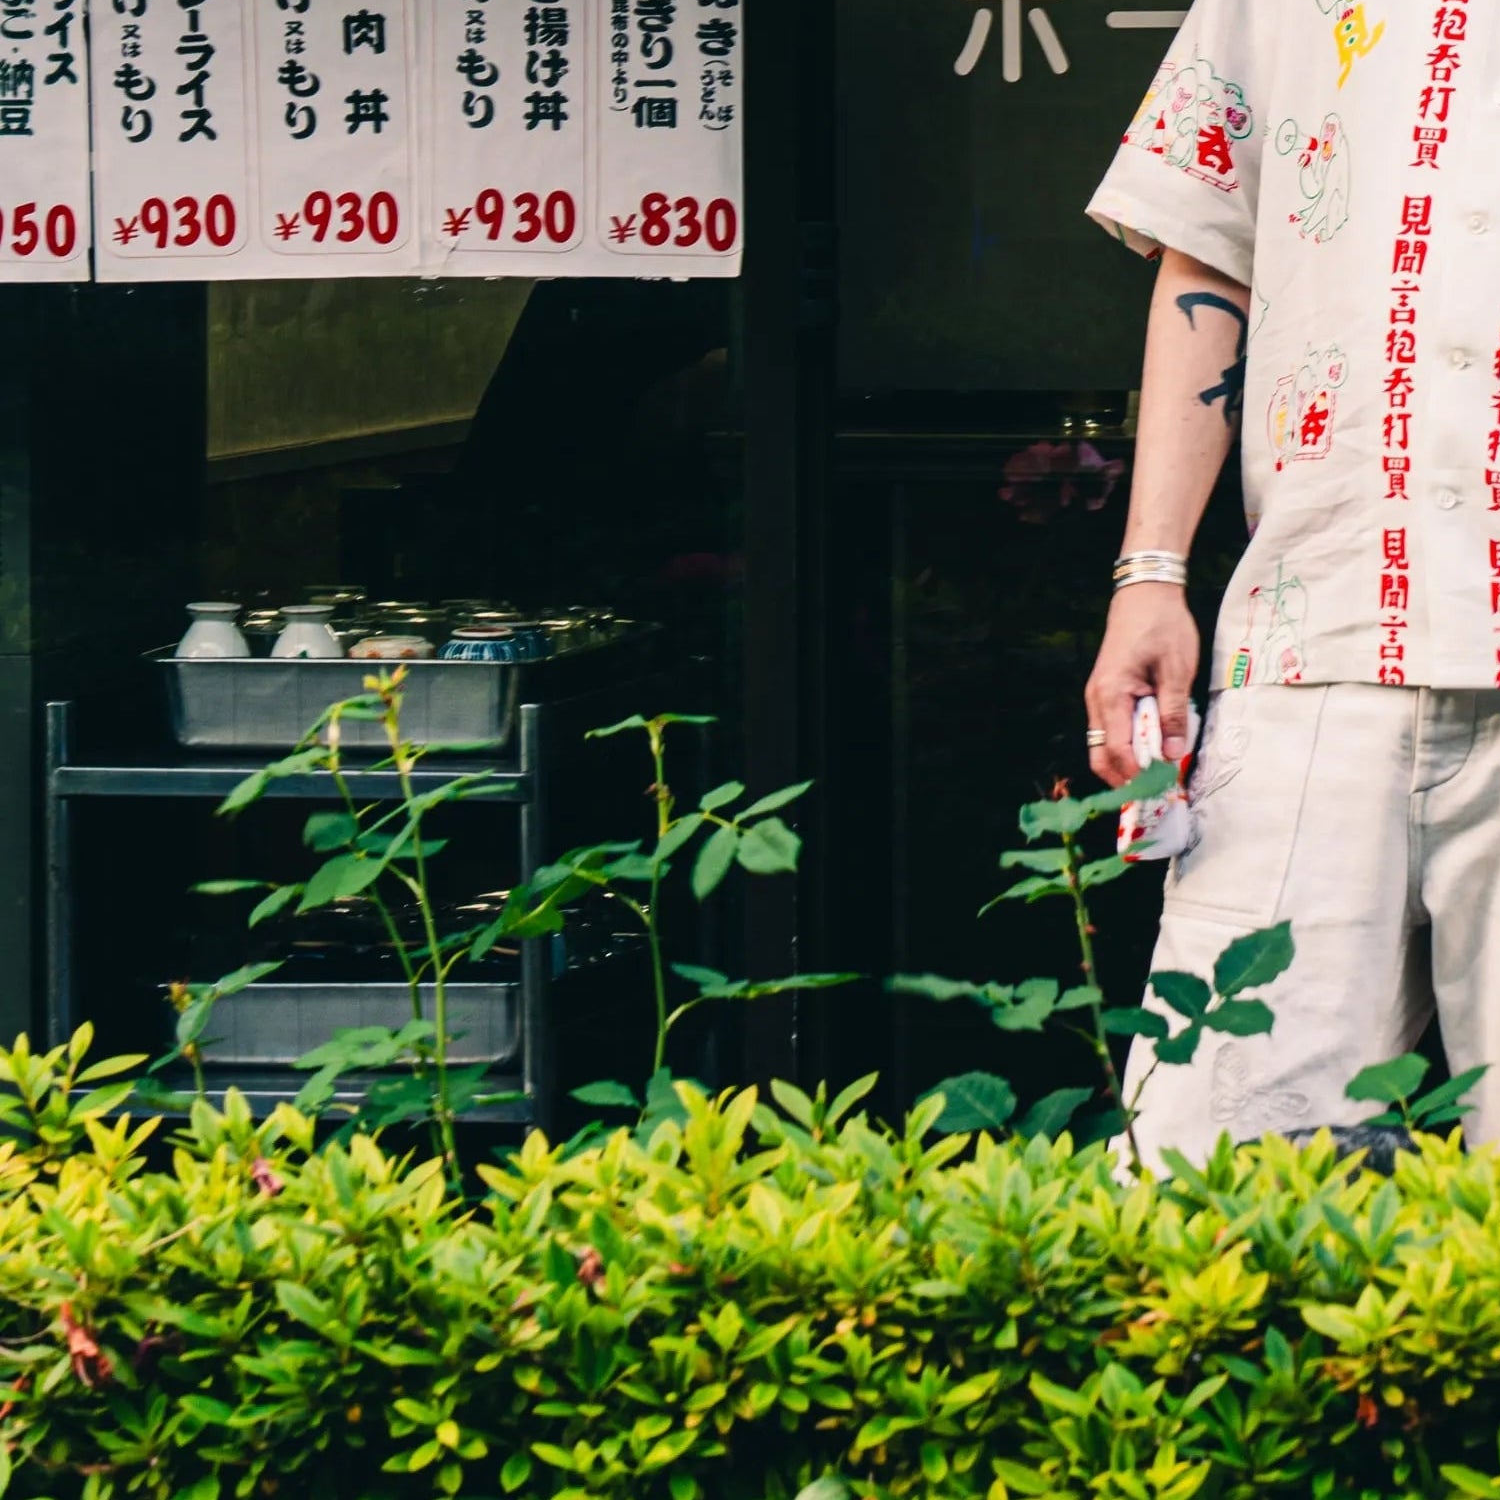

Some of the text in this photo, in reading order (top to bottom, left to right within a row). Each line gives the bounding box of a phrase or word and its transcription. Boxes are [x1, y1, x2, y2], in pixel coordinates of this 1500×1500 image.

[0, 202, 76, 257] 50
[113, 194, 236, 248] ¥930
[275, 191, 398, 244] ¥930
[443, 189, 575, 243] ¥930
[610, 193, 737, 252] ¥830
[1382, 195, 1432, 500] 見聞言抱呑打買
